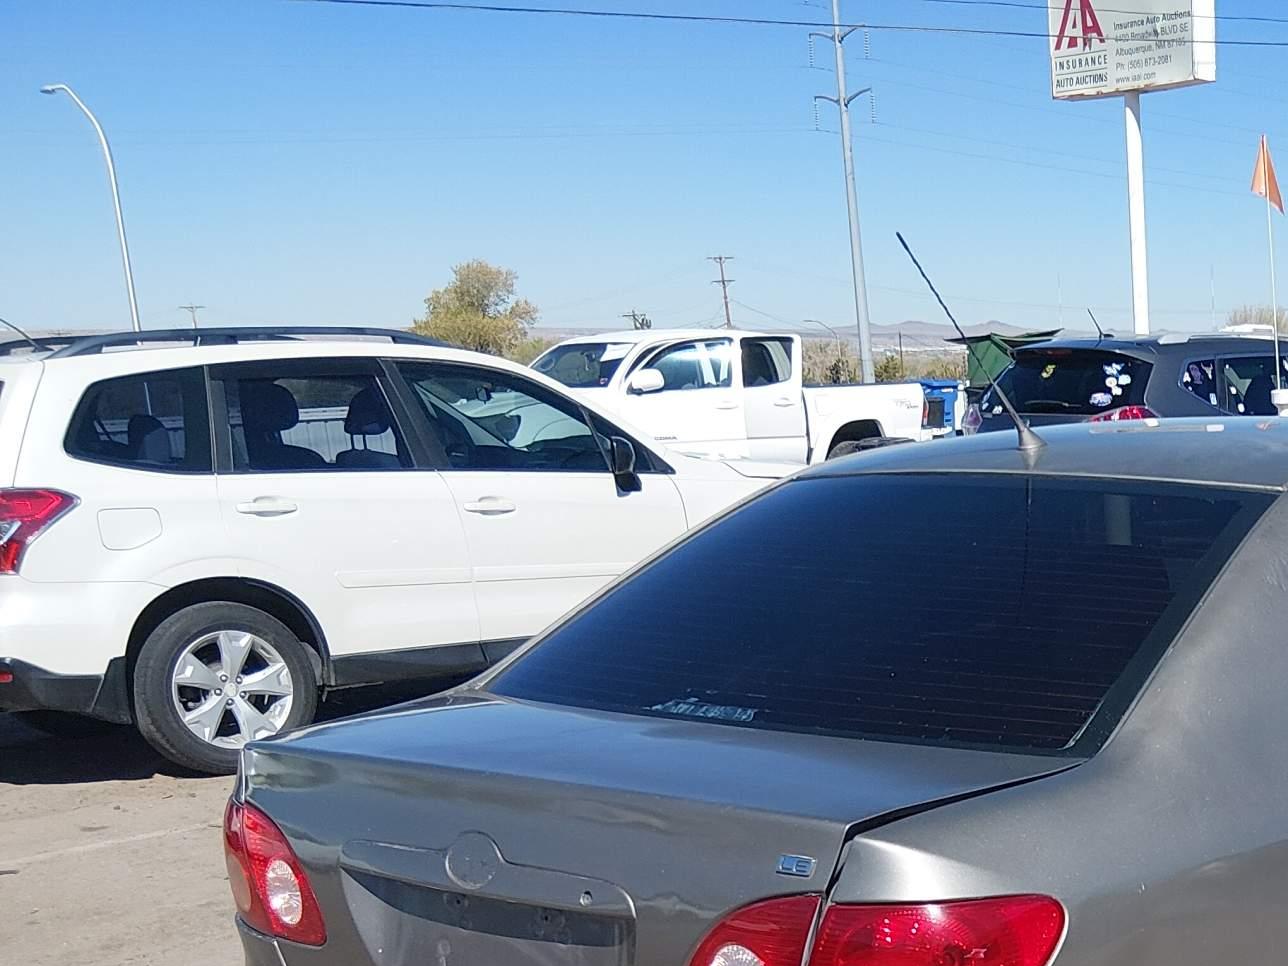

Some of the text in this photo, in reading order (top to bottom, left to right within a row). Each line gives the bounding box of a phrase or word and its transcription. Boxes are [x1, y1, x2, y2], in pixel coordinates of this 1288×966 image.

[1113, 10, 1191, 31] Insurance Auto Auctions
[1160, 24, 1178, 36] BLVD
[1179, 22, 1189, 33] SE
[1055, 54, 1108, 71] INSURANCE
[1056, 71, 1108, 88] AUTO AUCTIONS
